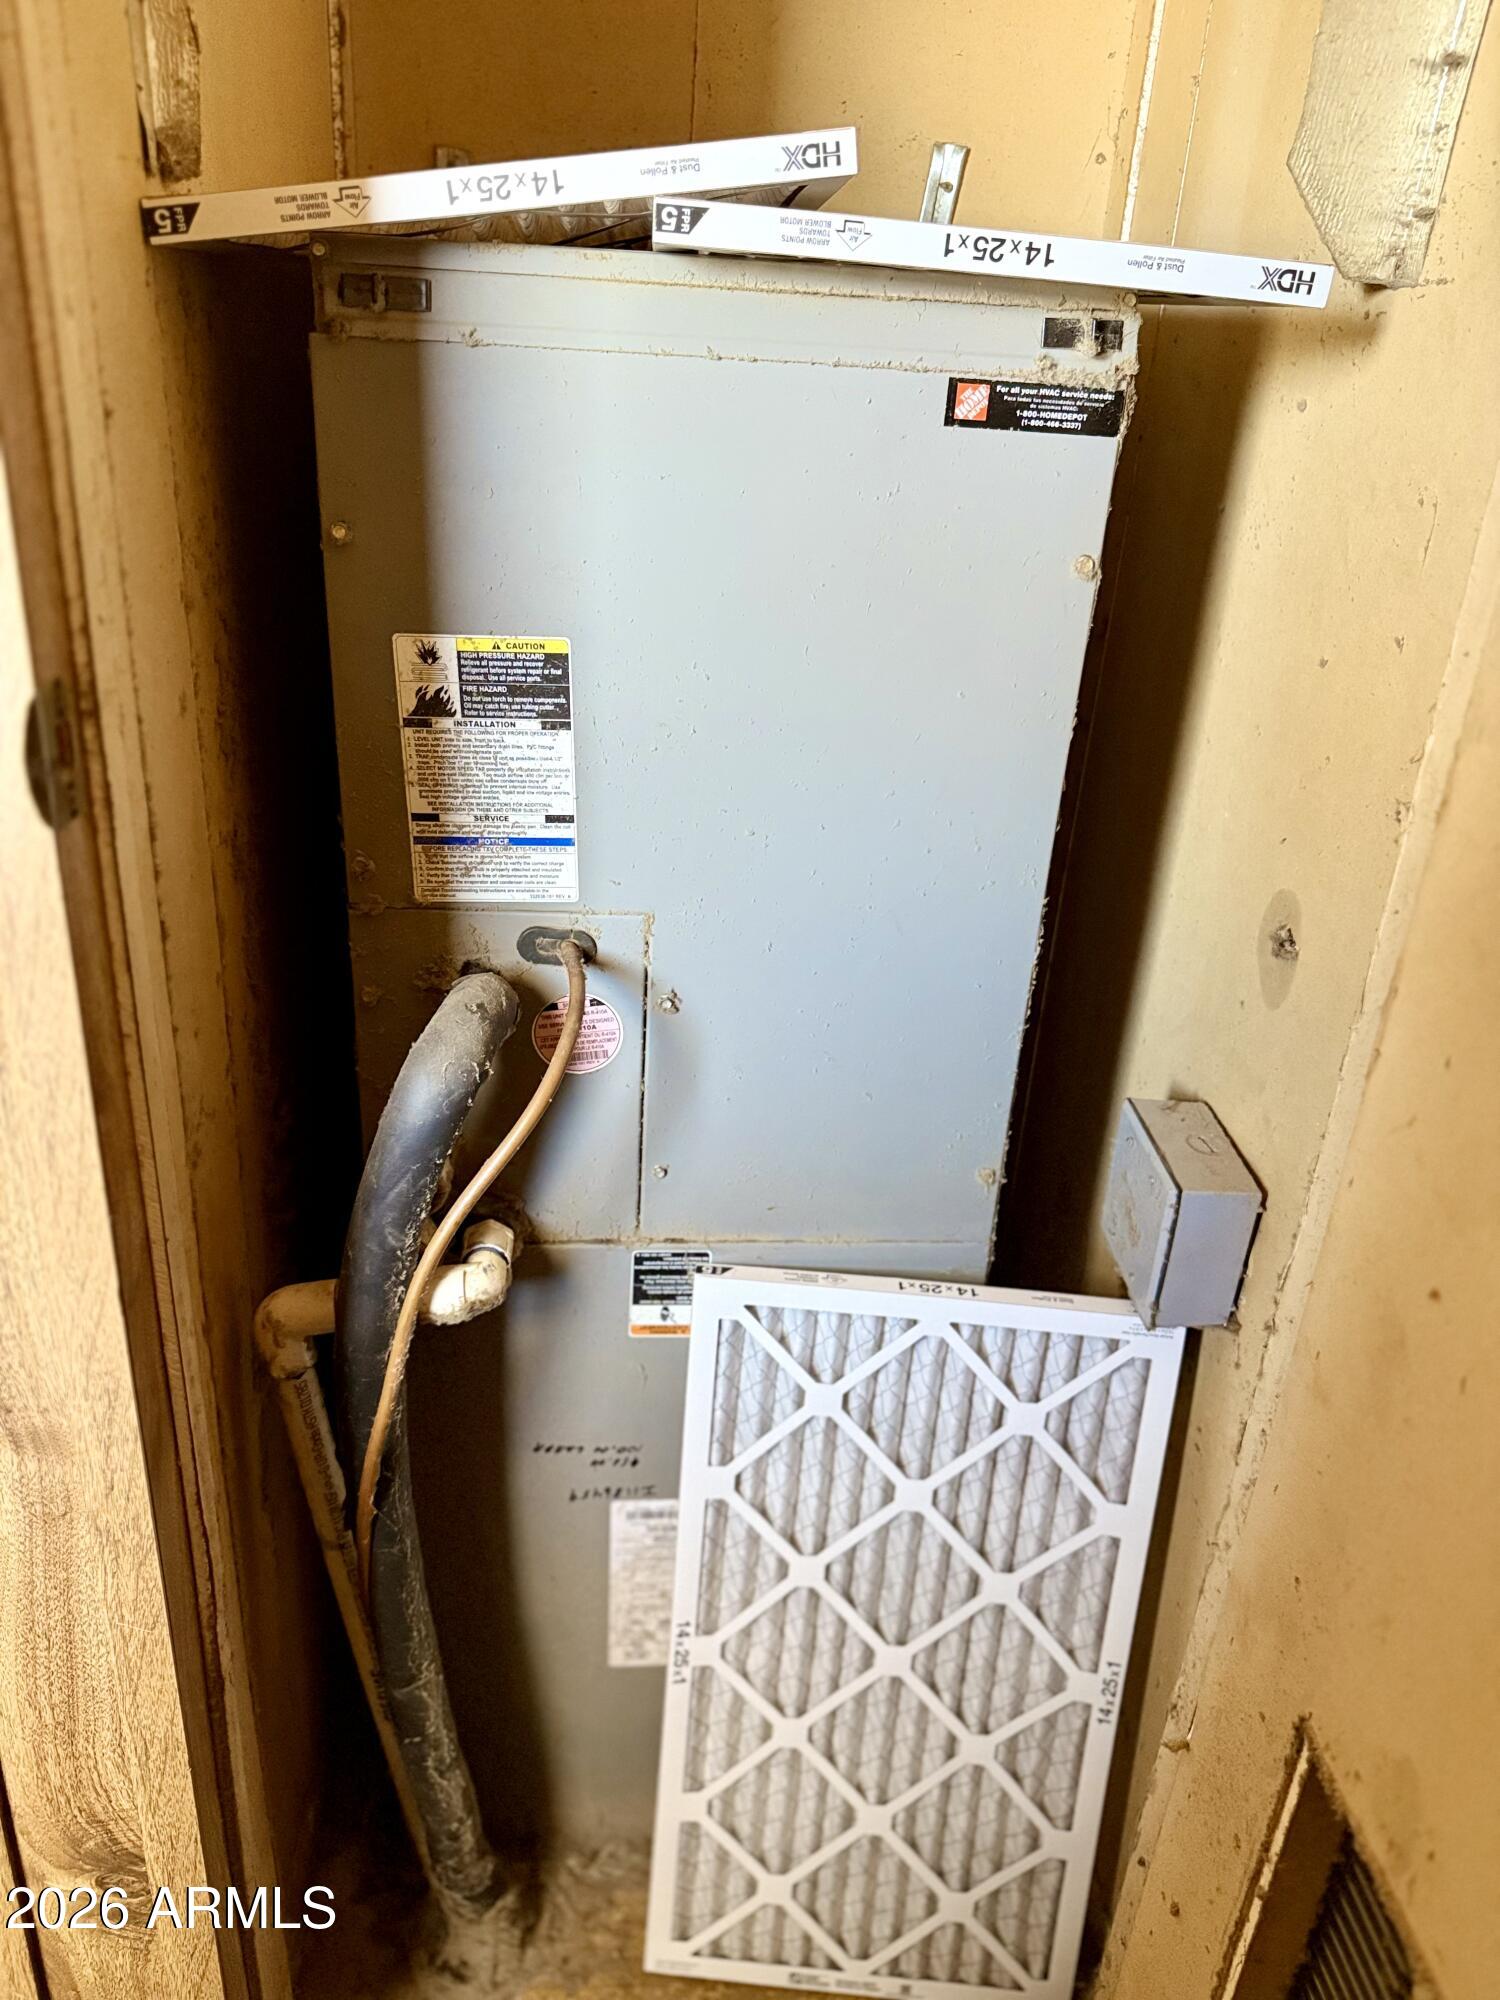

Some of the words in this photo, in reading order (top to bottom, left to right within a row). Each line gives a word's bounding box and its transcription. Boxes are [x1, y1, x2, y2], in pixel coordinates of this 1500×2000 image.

[781, 140, 841, 171] HDX
[639, 165, 667, 177] Pollen
[670, 164, 677, 174] &
[679, 162, 700, 173] Dust
[273, 194, 297, 204] MOTOR
[298, 191, 327, 201] BLOWER
[344, 192, 360, 202] Flow
[295, 200, 329, 211] TOWARDS
[349, 201, 359, 209] Air
[173, 206, 186, 232] FPR
[280, 212, 304, 222] POINTS
[306, 210, 331, 219] ARROW
[660, 205, 677, 231] 5
[680, 207, 690, 232] FPR
[152, 207, 173, 233] 5
[779, 215, 802, 225] MOTOR
[804, 218, 831, 228] BLOWER
[799, 227, 830, 236] TOWARDS
[846, 226, 862, 234] Flow
[780, 234, 804, 243] POINTS
[806, 236, 830, 245] ARROW
[1126, 258, 1153, 269] Pollen
[1155, 261, 1162, 270] &
[1163, 262, 1184, 272] Dust
[1256, 265, 1316, 294] HDX
[996, 384, 1008, 394] For
[1010, 386, 1019, 394] all
[1021, 386, 1037, 396] your
[1039, 388, 1060, 397] HVAC
[1061, 390, 1087, 399] service
[1088, 392, 1114, 401] needs:
[954, 384, 989, 420] HOME
[1015, 409, 1087, 421] 1-800-HOMEDEPOT
[505, 642, 545, 650] CAUTION
